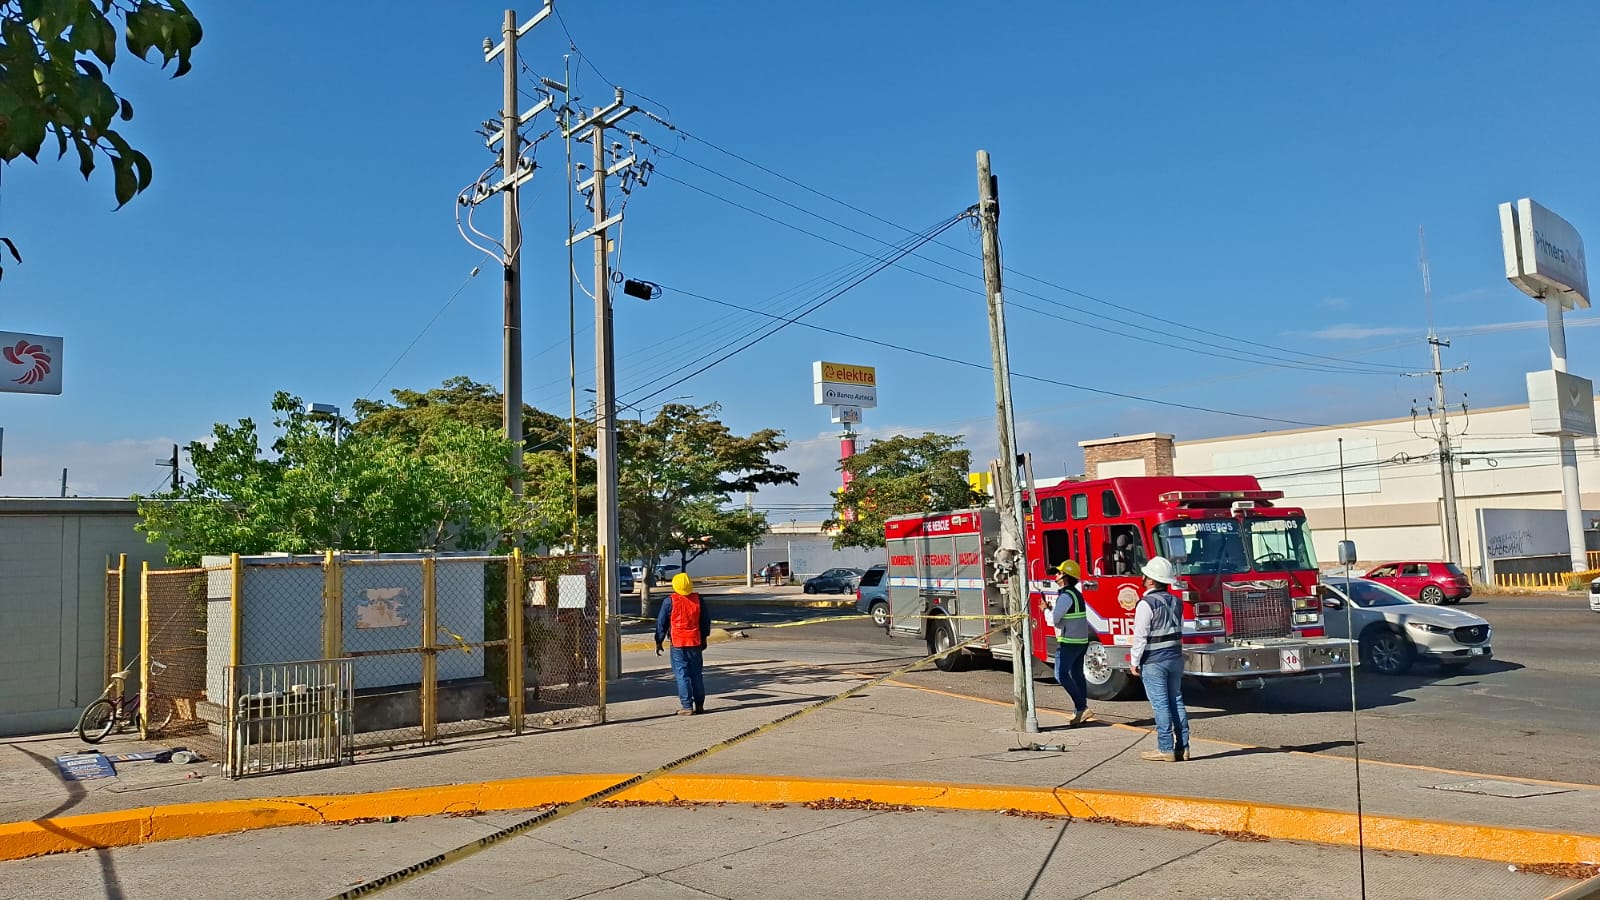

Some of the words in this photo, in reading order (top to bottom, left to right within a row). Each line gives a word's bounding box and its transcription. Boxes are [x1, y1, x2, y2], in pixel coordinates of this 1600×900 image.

[1534, 230, 1566, 263] Primera
[836, 367, 874, 383] elektra
[836, 391, 854, 400] Banco
[854, 393, 874, 401] Azteca
[922, 521, 932, 532] FIRE
[932, 519, 950, 531] RESCUE
[1185, 522, 1234, 533] BOMBEROS
[1250, 519, 1298, 532] VENOS
[921, 553, 951, 566] VETERANOS
[1109, 617, 1135, 635] FIR
[1286, 655, 1297, 664] 18
